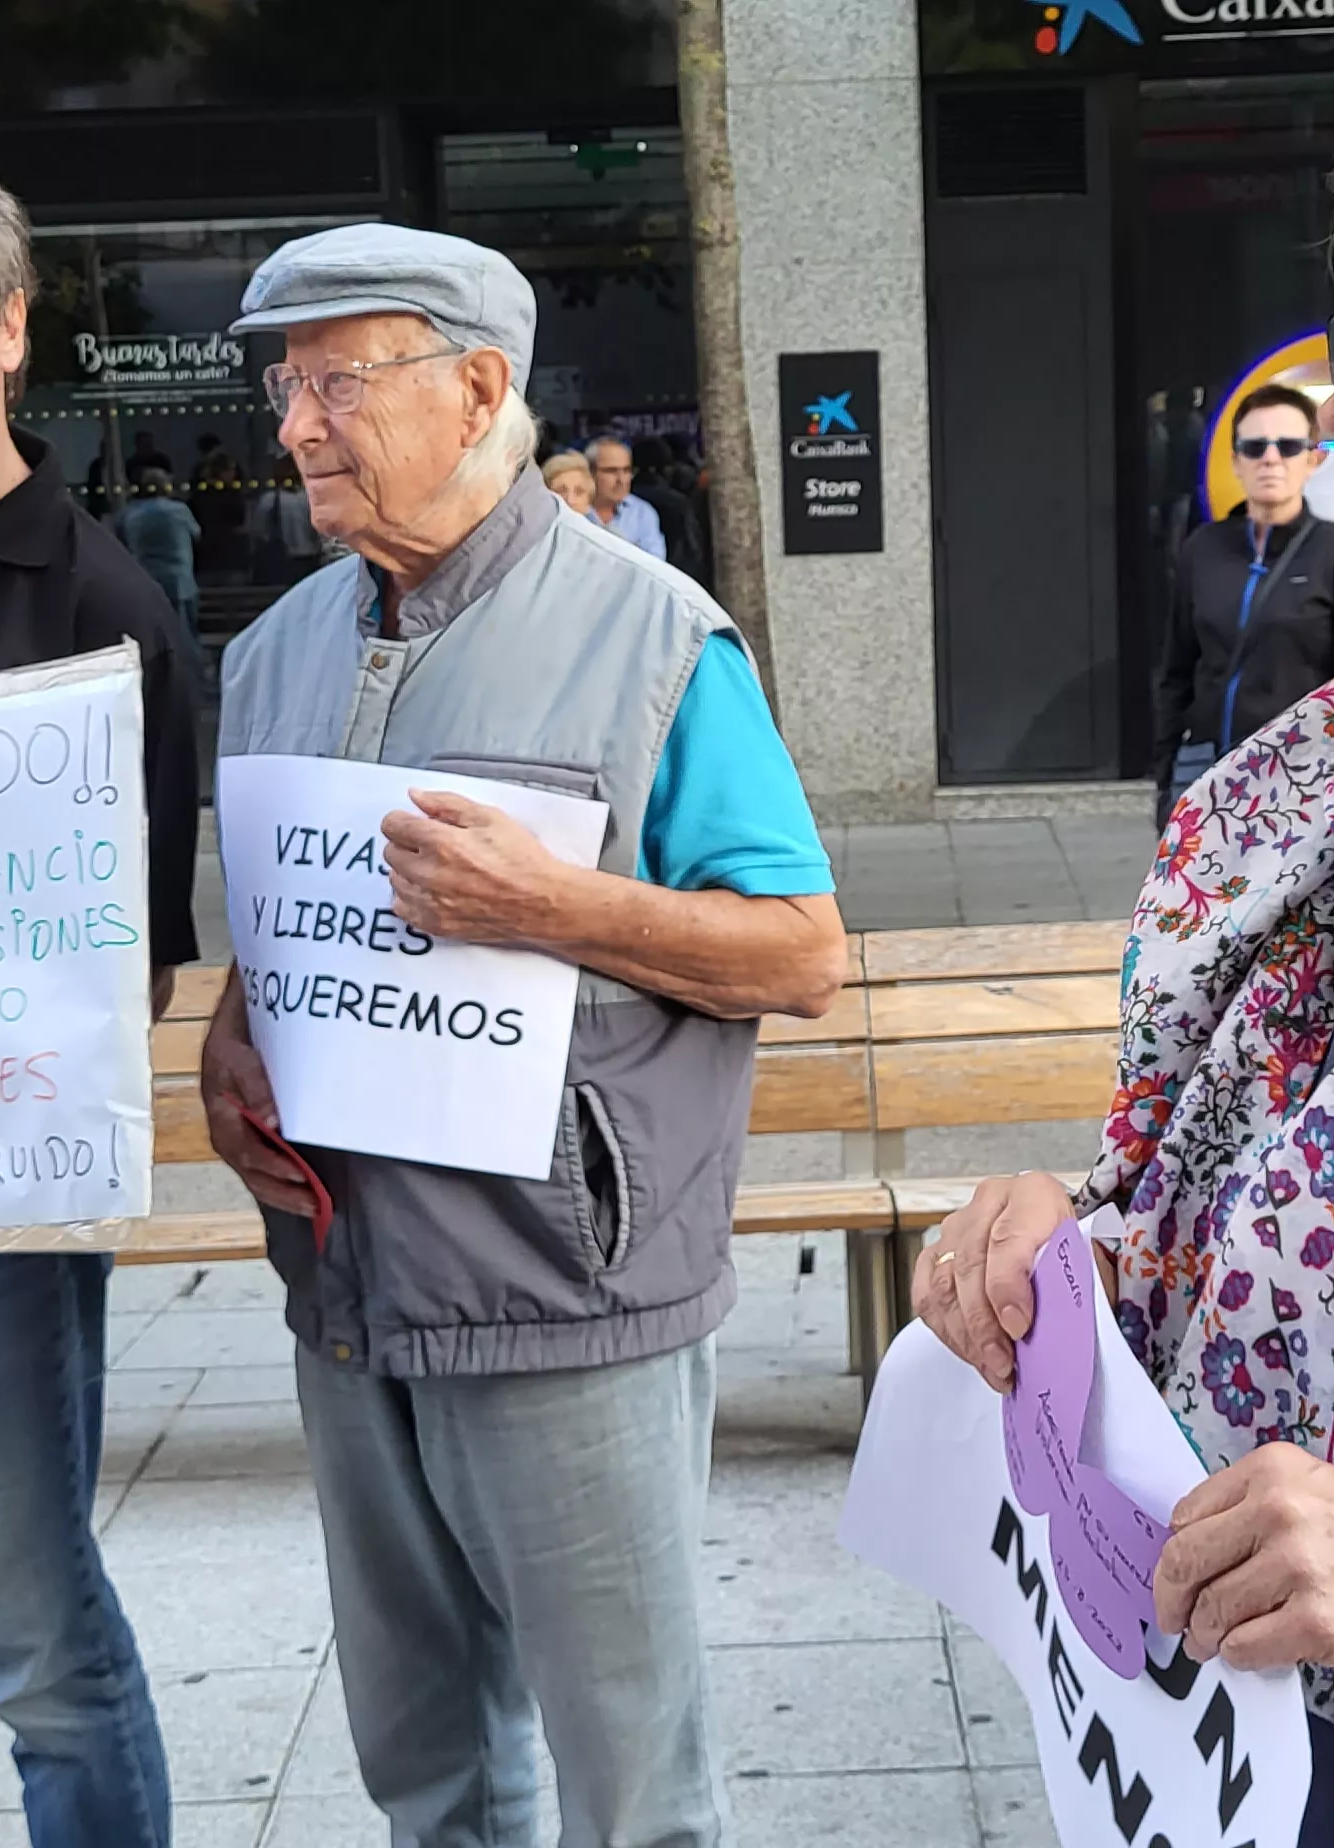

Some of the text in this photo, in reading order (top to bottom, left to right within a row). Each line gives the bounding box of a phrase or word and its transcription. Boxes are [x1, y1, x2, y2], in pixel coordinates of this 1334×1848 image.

[804, 478, 861, 499] Store
[277, 824, 390, 876] VIVA
[252, 894, 434, 956] Y LIBRES
[264, 969, 524, 1046] QUEREMOS
[990, 1496, 1174, 1848] MEN
